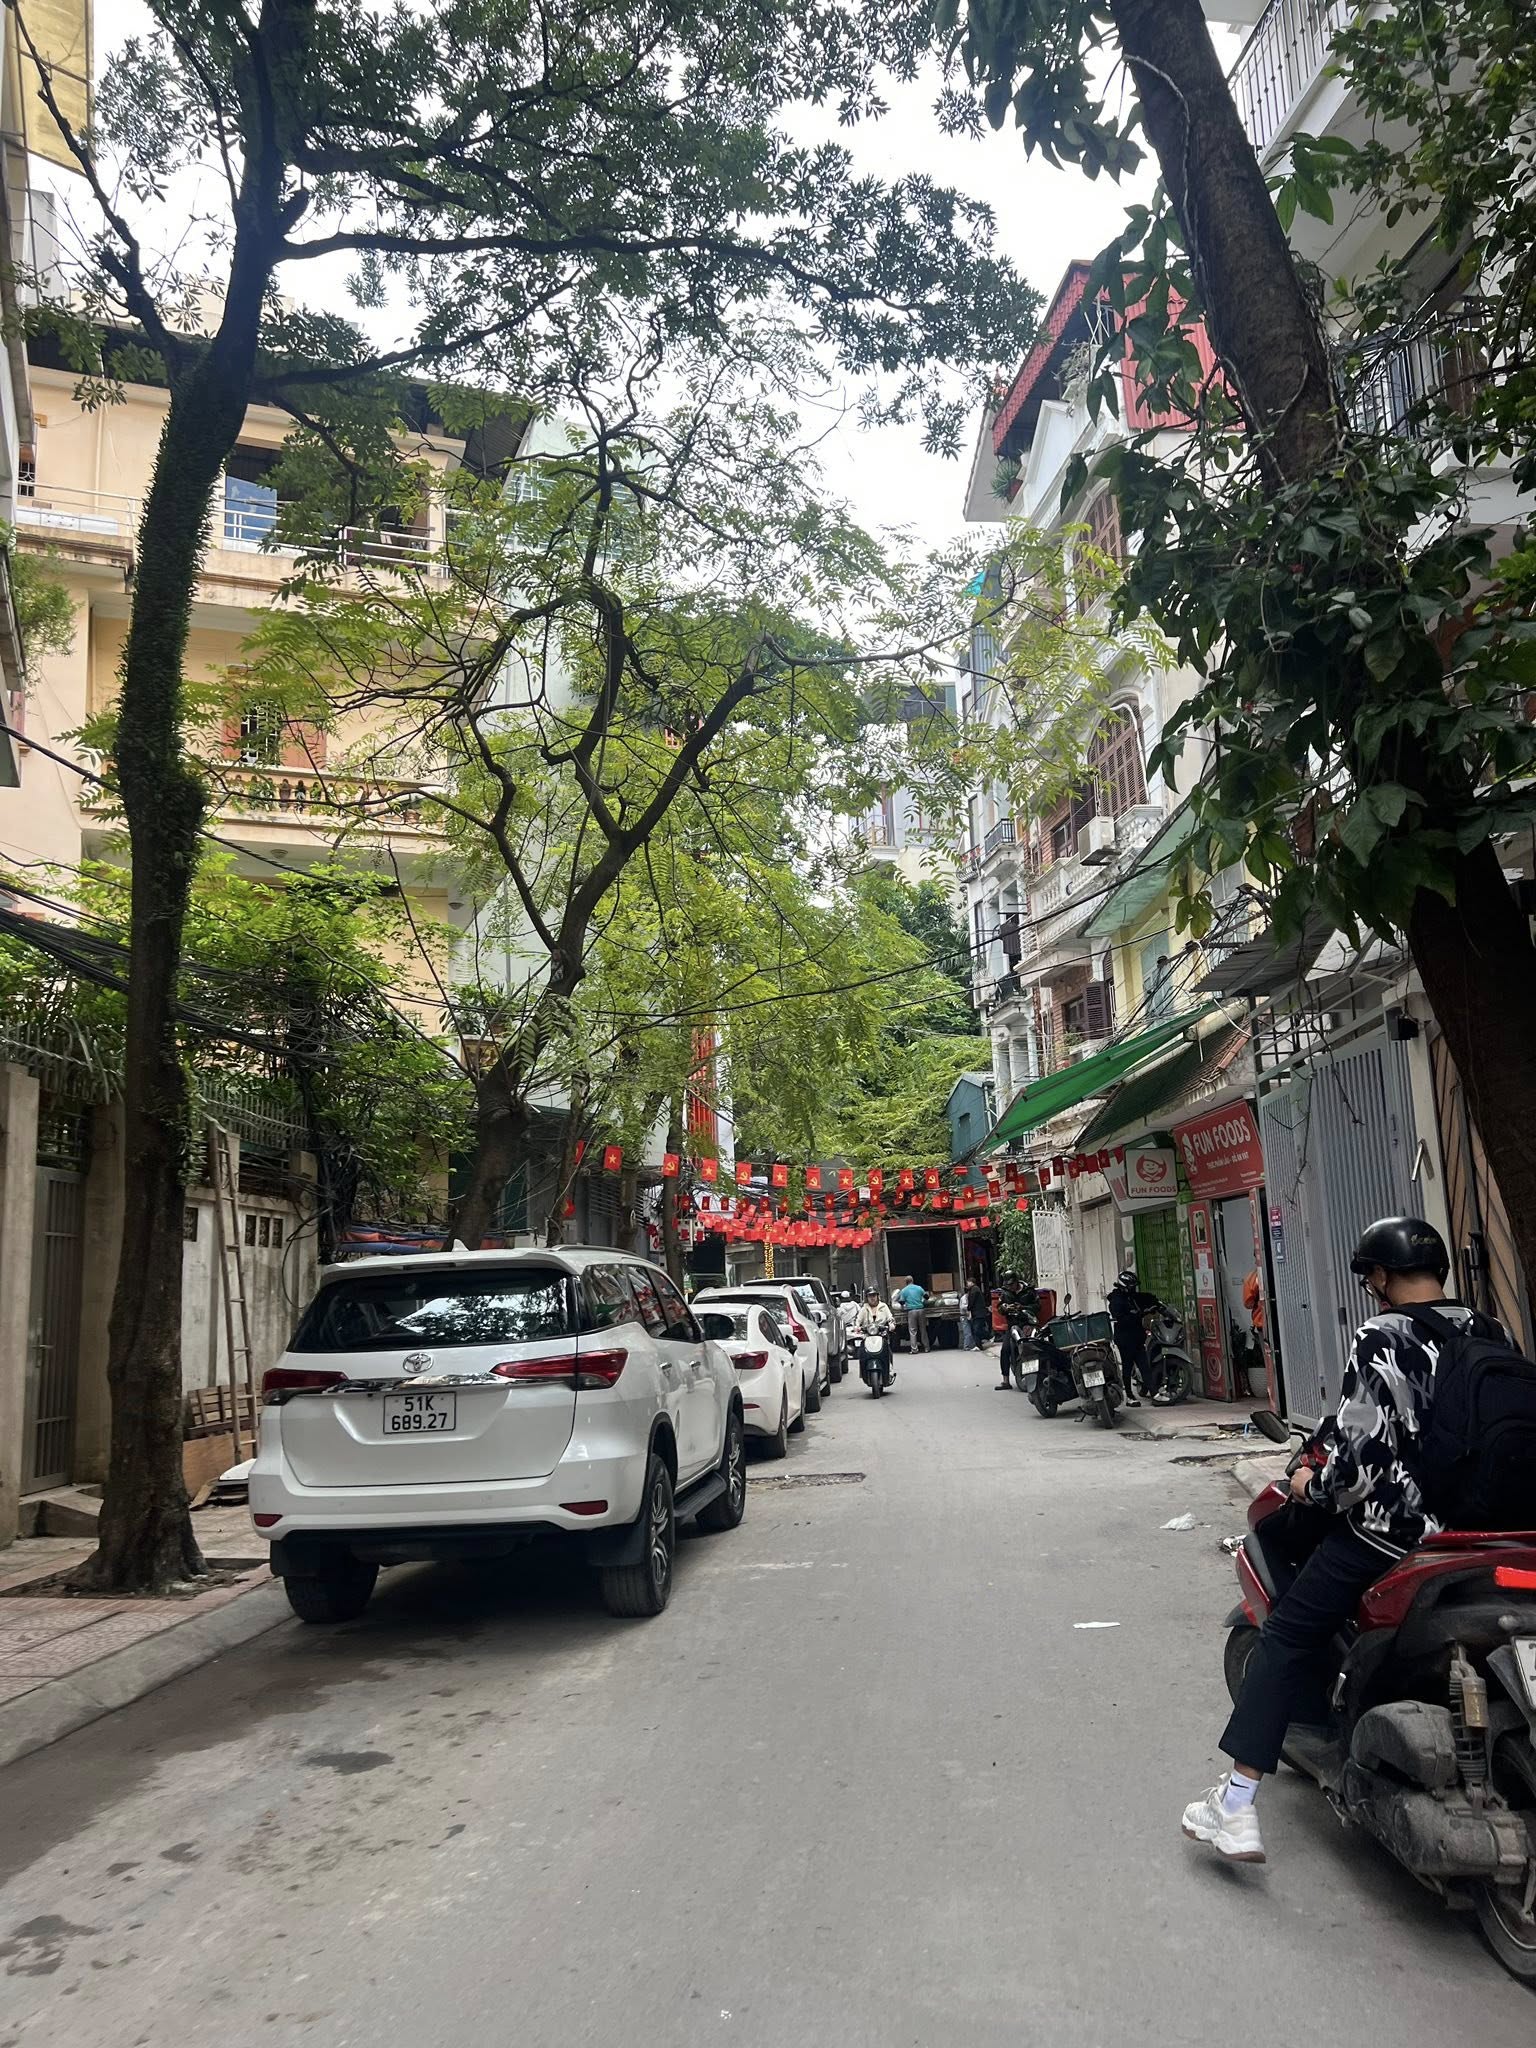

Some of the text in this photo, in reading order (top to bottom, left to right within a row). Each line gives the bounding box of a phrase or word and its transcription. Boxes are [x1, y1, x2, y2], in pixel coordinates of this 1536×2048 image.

[1193, 1116, 1251, 1156] FUN FOODS
[1149, 1185, 1177, 1193] FOODS
[404, 1395, 434, 1412] 51K
[391, 1412, 448, 1431] 689.27
